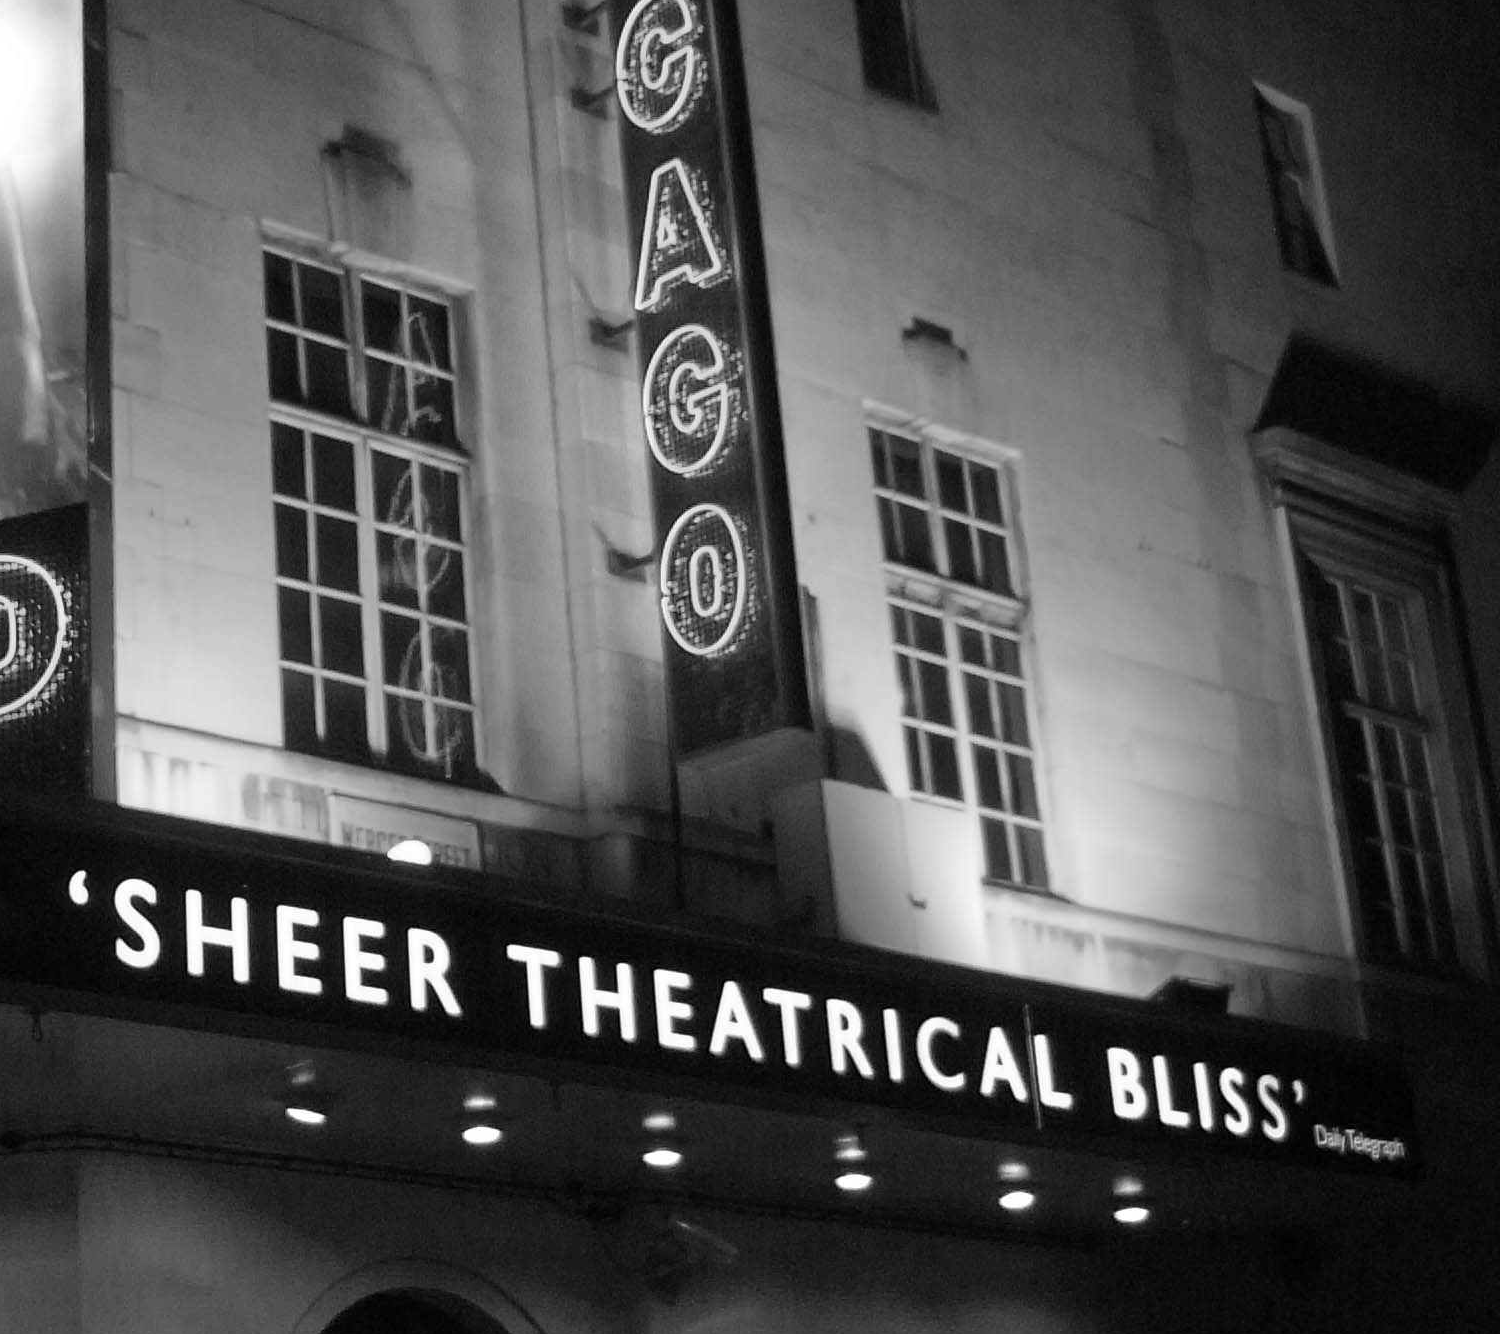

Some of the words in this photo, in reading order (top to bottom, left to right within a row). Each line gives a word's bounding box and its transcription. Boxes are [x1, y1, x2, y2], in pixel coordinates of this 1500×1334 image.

[505, 943, 1074, 1109] THEATRICAL
[1313, 1124, 1346, 1155] Daily
[1345, 1128, 1406, 1161] Telegraph
